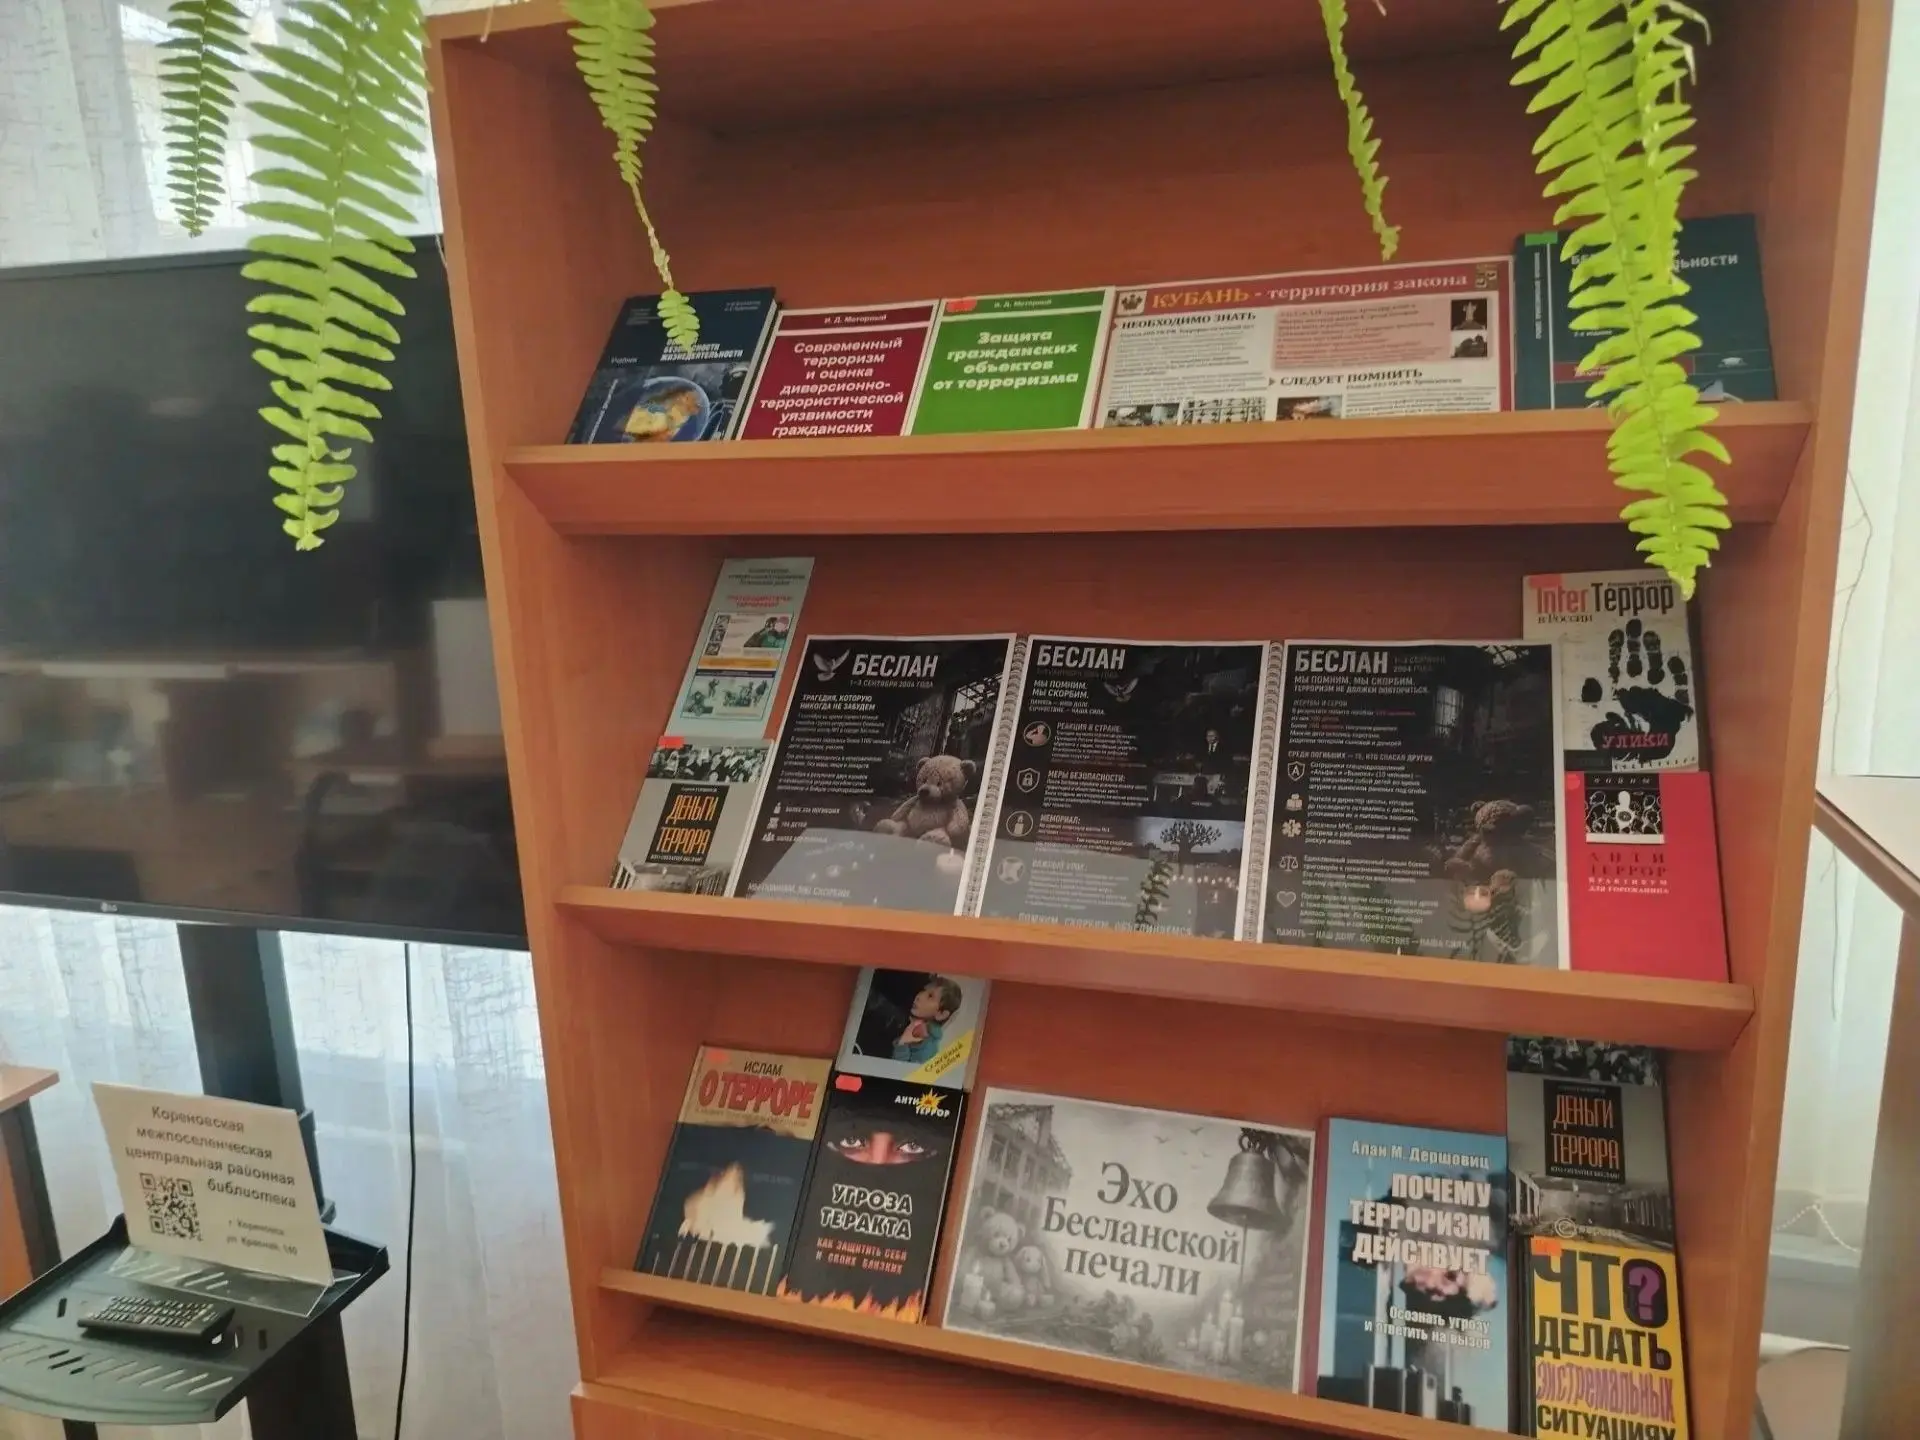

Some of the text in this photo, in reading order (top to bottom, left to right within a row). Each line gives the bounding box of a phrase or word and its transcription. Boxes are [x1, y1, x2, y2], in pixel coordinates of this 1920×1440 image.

[1152, 288, 1250, 308] КУБАНЬ
[1268, 278, 1389, 301] территория
[1393, 275, 1467, 289] закона
[1122, 312, 1256, 329] НЕОБХОДИМО ЗНАТЬ
[794, 338, 902, 353] Современный
[977, 331, 1053, 345] Защита
[803, 353, 884, 367] терроризм
[947, 344, 1078, 362] гражданских
[806, 368, 873, 379] и оценка
[964, 360, 1053, 374] объектов
[1281, 375, 1344, 386] СЛЕДУЕТ
[1347, 368, 1423, 383] ПОМНИТЬ
[780, 382, 890, 395] диверсионно-
[933, 373, 1078, 391] от терроризма
[760, 392, 903, 409] террористической
[780, 409, 873, 423] уязвимости
[772, 422, 873, 437] гражданских
[1537, 582, 1674, 616] Inter Террор
[1549, 614, 1592, 623] России
[852, 654, 938, 678] БЕСЛАН
[1037, 645, 1126, 670] БЕСЛАН
[1295, 650, 1388, 673] БЕСЛАН
[1295, 676, 1308, 684] МЫ
[1602, 732, 1669, 749] УЛИКИ
[1311, 751, 1346, 759] ПОГИБШИХ
[1070, 771, 1125, 782] БЕЗОПАСНОСТИ:
[666, 794, 719, 825] ДЕНЬГИ
[1040, 814, 1081, 824] МЕМОРИАЛ:
[656, 827, 711, 855] ТЕРРОРА
[1277, 927, 1306, 938] ПАМЯТЬ
[1316, 931, 1334, 940] НАШ
[1359, 933, 1410, 946] СОЧУВСТВИЕ
[743, 1061, 784, 1076] ИСЛАМ
[698, 1069, 719, 1107] О
[718, 1072, 818, 1119] ТЕРРОРЕ
[894, 1095, 920, 1105] АНТИ
[151, 1105, 244, 1134] Кореновская
[915, 1106, 950, 1118] ТЕРРОР
[1553, 1094, 1614, 1130] ДЕНЬГИ
[136, 1127, 273, 1160] межпоселенческая
[1352, 1140, 1490, 1170] Алан М. Дершовиц
[1550, 1132, 1620, 1170] ТЕРРОРА
[125, 1146, 295, 1186] центральная районная
[206, 1177, 297, 1209] библиотека
[832, 1183, 913, 1215] УГРОЗА
[1096, 1160, 1178, 1214] Эхо
[1391, 1172, 1491, 1209] ПОЧЕМУ
[820, 1206, 912, 1240] ТЕРАКТА
[1042, 1195, 1240, 1265] Бесланской
[1349, 1200, 1490, 1242] ТЕРРОРИЗМ
[817, 1237, 907, 1260] КАК ЗАЩИТИТЬ СЕБЯ
[1352, 1231, 1490, 1276] ДЕЙСТВУЕТ
[816, 1250, 903, 1274] И СВОИХ БЛИЗКИХ
[1063, 1247, 1202, 1297] печали
[1389, 1305, 1490, 1335] Осознать угрозу
[1364, 1321, 1491, 1349] и ответить на вызов
[1531, 1315, 1672, 1371] ДЕЛАТЬ
[1536, 1361, 1676, 1424] ЭКСТРЕМАЛЬНЫХ
[1537, 1404, 1676, 1440] СИТУАЦИЯХ
